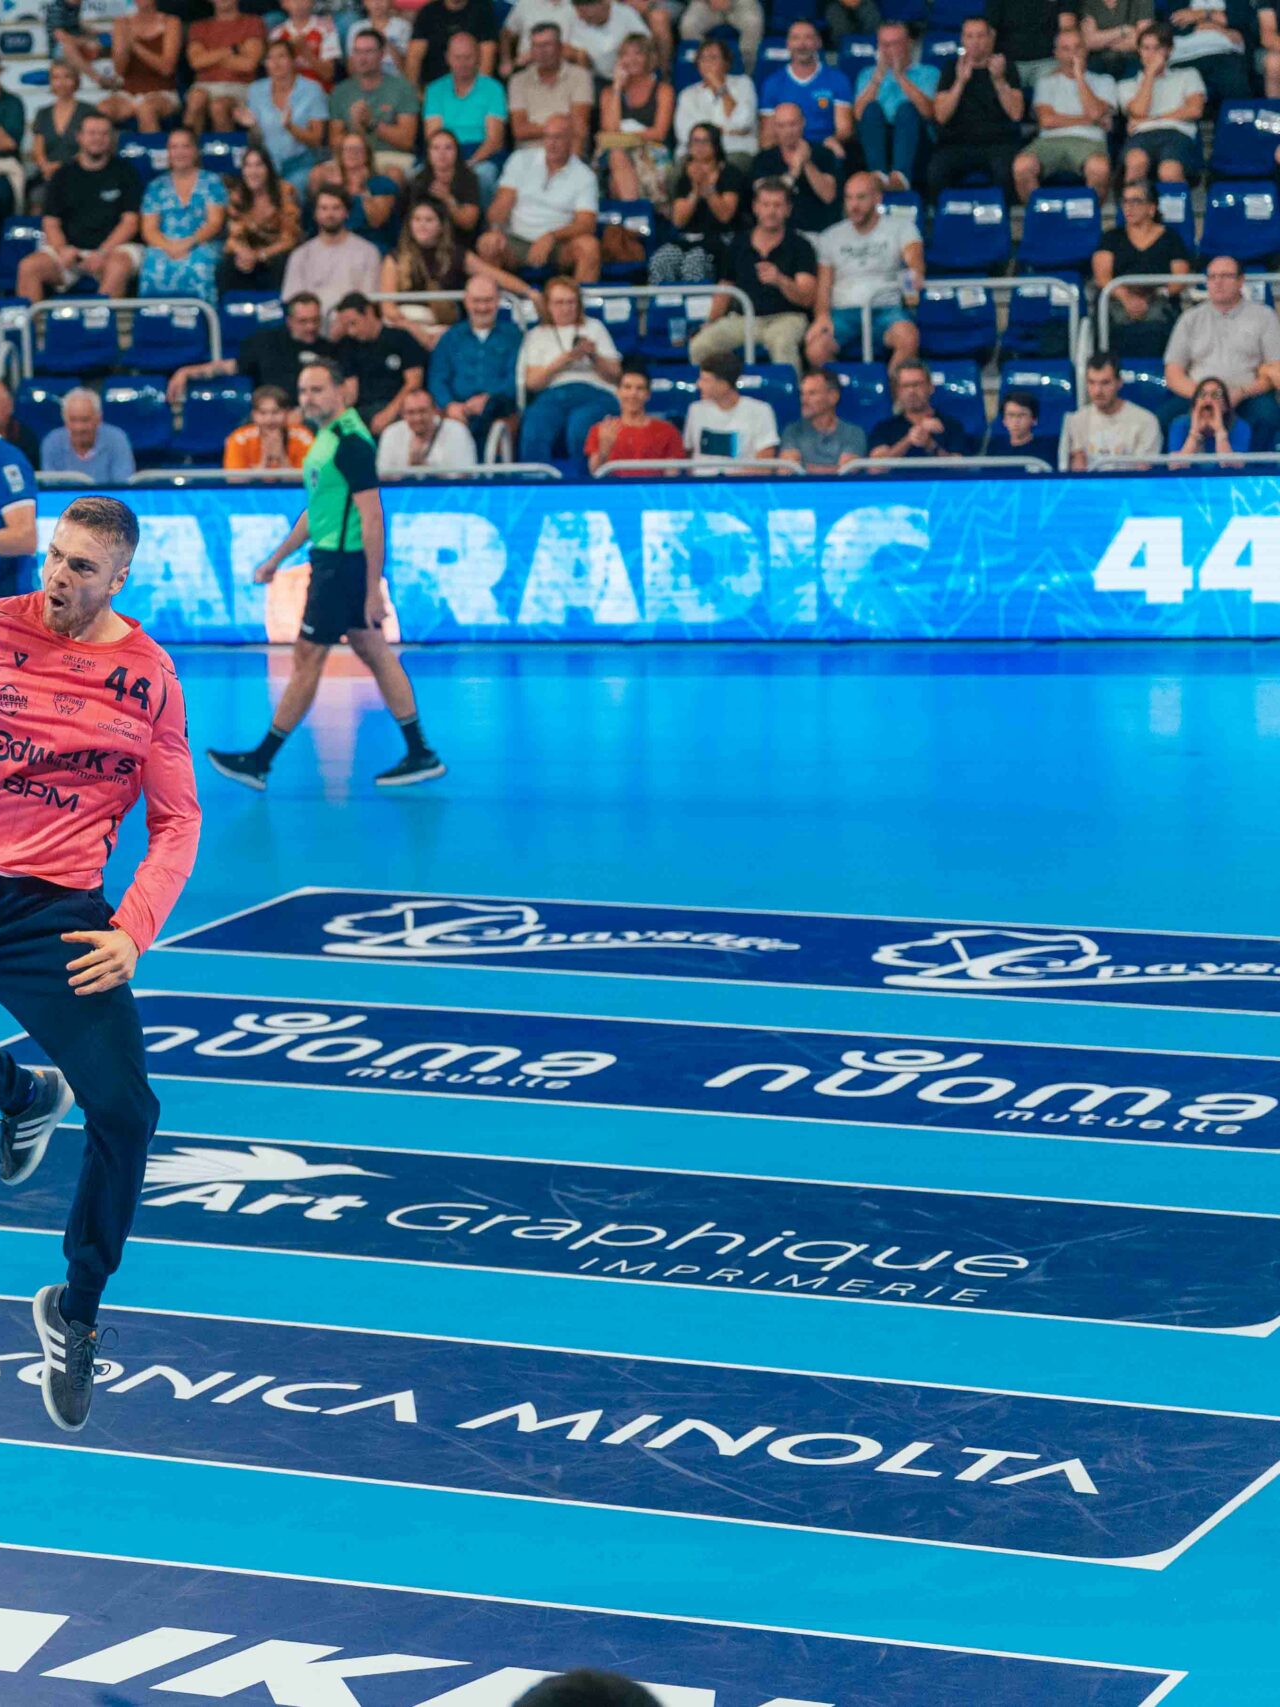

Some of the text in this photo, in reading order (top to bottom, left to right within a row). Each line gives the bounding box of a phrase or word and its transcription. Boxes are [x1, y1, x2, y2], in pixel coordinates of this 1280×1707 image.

[391, 506, 929, 626] RADIC
[1091, 516, 1280, 603] 44
[105, 665, 152, 710] 44
[97, 721, 143, 743] collecteam
[4, 772, 80, 812] BPM
[1096, 962, 1280, 979] pays
[346, 1066, 573, 1091] mutuelle
[992, 1106, 1243, 1136] mutuelle
[142, 1182, 1030, 1282] Art Graphique
[578, 1257, 989, 1304] IMPRIMERIE
[455, 1400, 1101, 1496] MINOLTA
